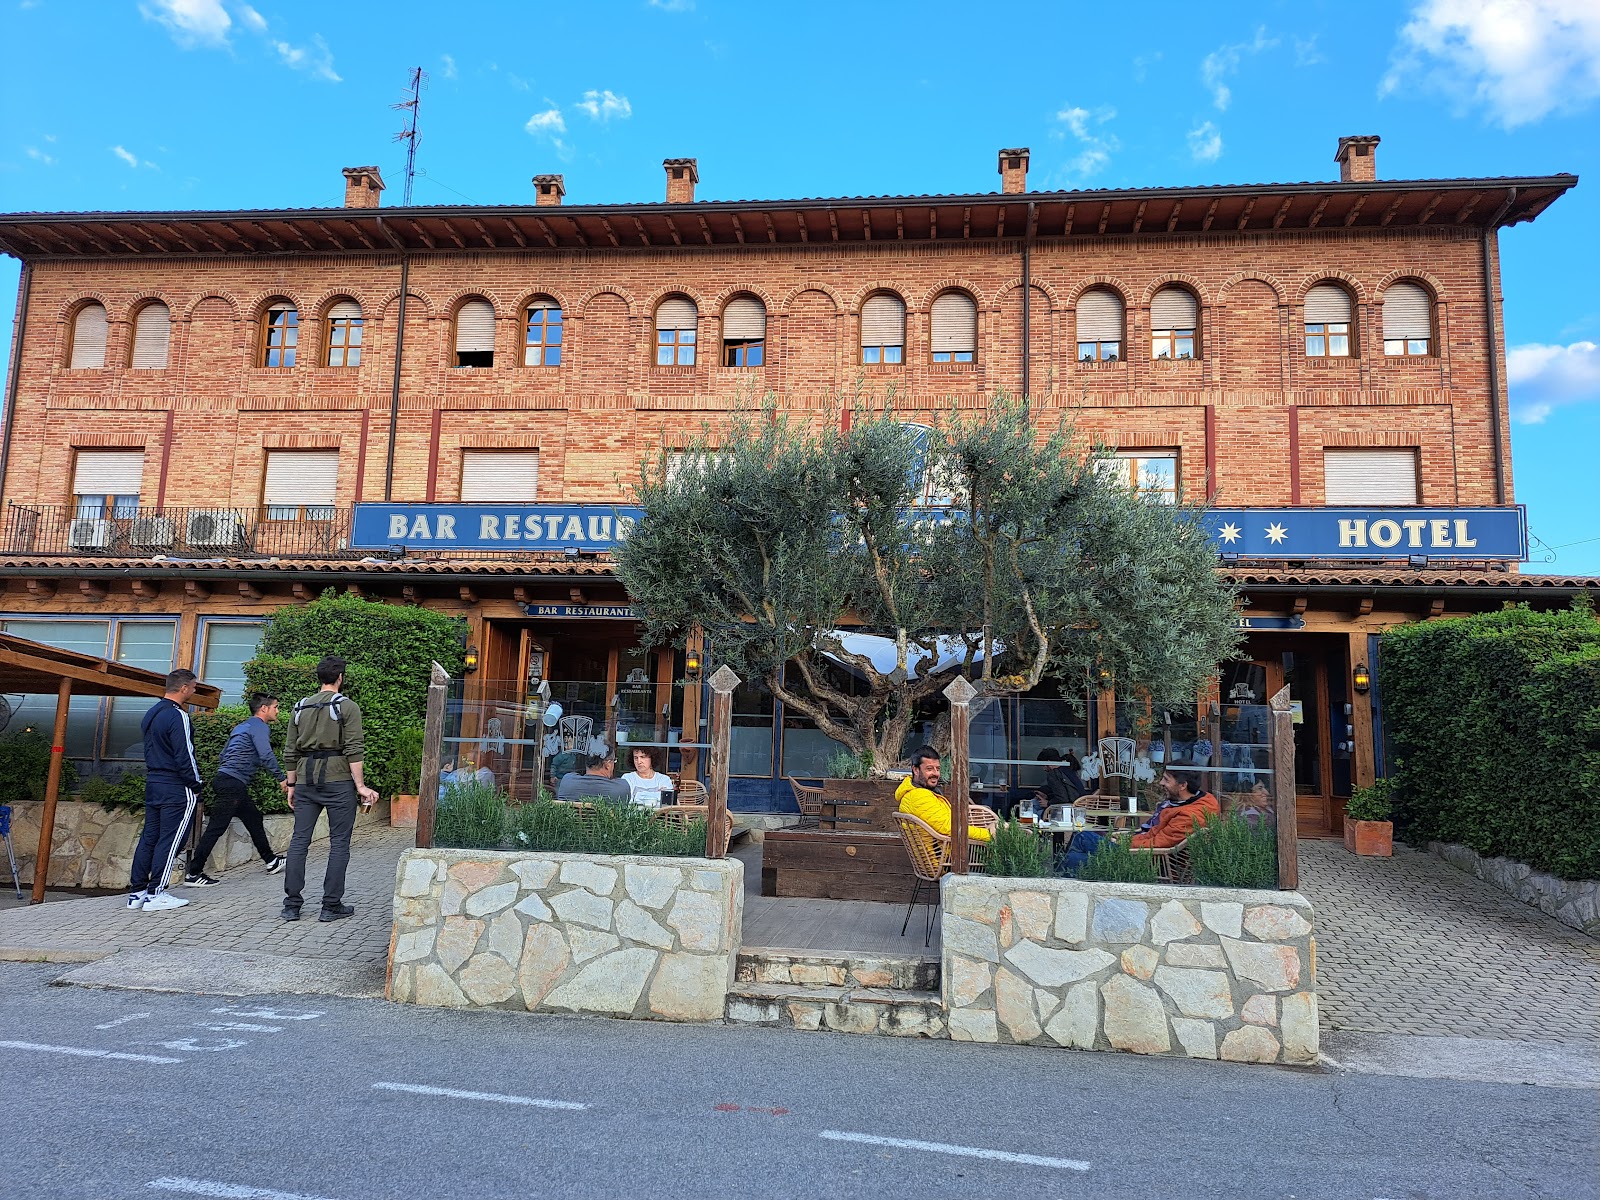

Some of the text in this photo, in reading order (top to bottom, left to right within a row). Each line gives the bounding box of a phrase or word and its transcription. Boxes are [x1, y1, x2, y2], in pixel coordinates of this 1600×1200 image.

[388, 513, 636, 541] BAR RESTAUR
[1337, 518, 1478, 548] HOTEL
[538, 606, 558, 615] BAR
